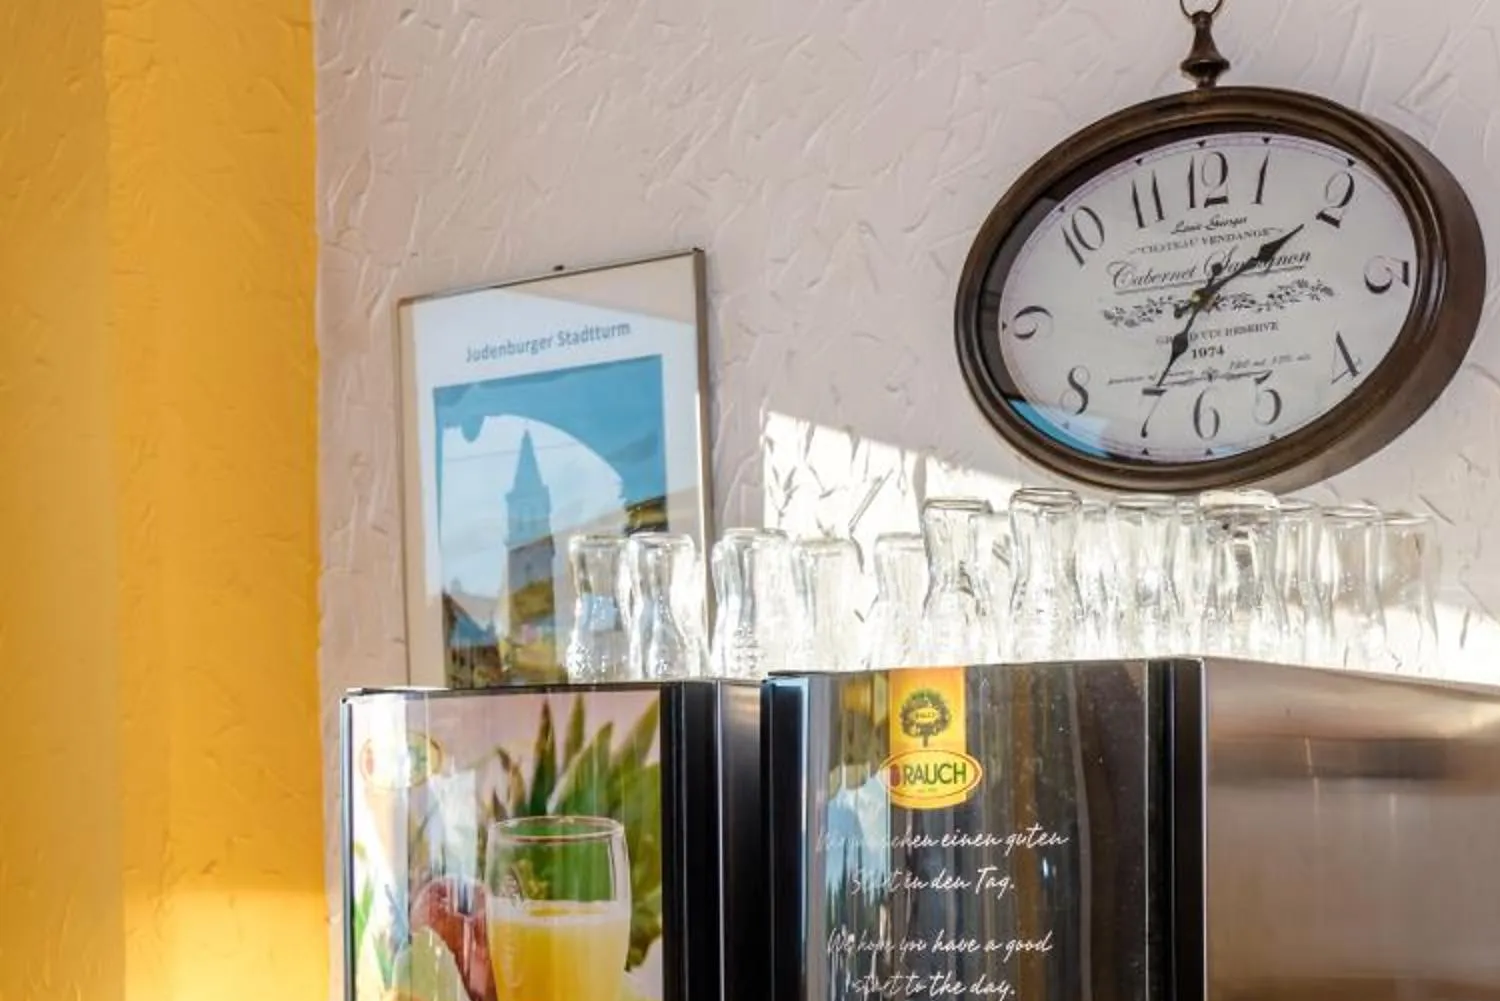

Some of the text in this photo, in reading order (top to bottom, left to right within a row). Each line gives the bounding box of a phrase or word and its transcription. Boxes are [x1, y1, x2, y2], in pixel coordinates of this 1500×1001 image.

[1130, 169, 1164, 229] 11
[1187, 151, 1230, 208] 12
[1253, 151, 1269, 205] 1
[1315, 171, 1355, 229] 2
[1061, 206, 1104, 266] 10
[1107, 261, 1196, 288] Cabernet
[1364, 255, 1409, 294] 3
[466, 322, 632, 363] Judenburger Stadtturm
[1013, 305, 1054, 339] 9
[1192, 344, 1225, 359] 1974
[1330, 331, 1362, 385] 4
[1059, 365, 1091, 415] 8
[1193, 386, 1220, 439] 6
[1251, 371, 1282, 424] 5
[1142, 388, 1166, 438] 7
[902, 762, 967, 785] RAUCH
[941, 828, 1002, 849] einen
[1005, 822, 1069, 856] guten
[930, 867, 972, 890] den
[899, 934, 927, 962] you
[931, 929, 981, 953] have
[983, 938, 1003, 953] a
[1003, 930, 1054, 963] good
[904, 970, 928, 997] to
[929, 970, 967, 997] the
